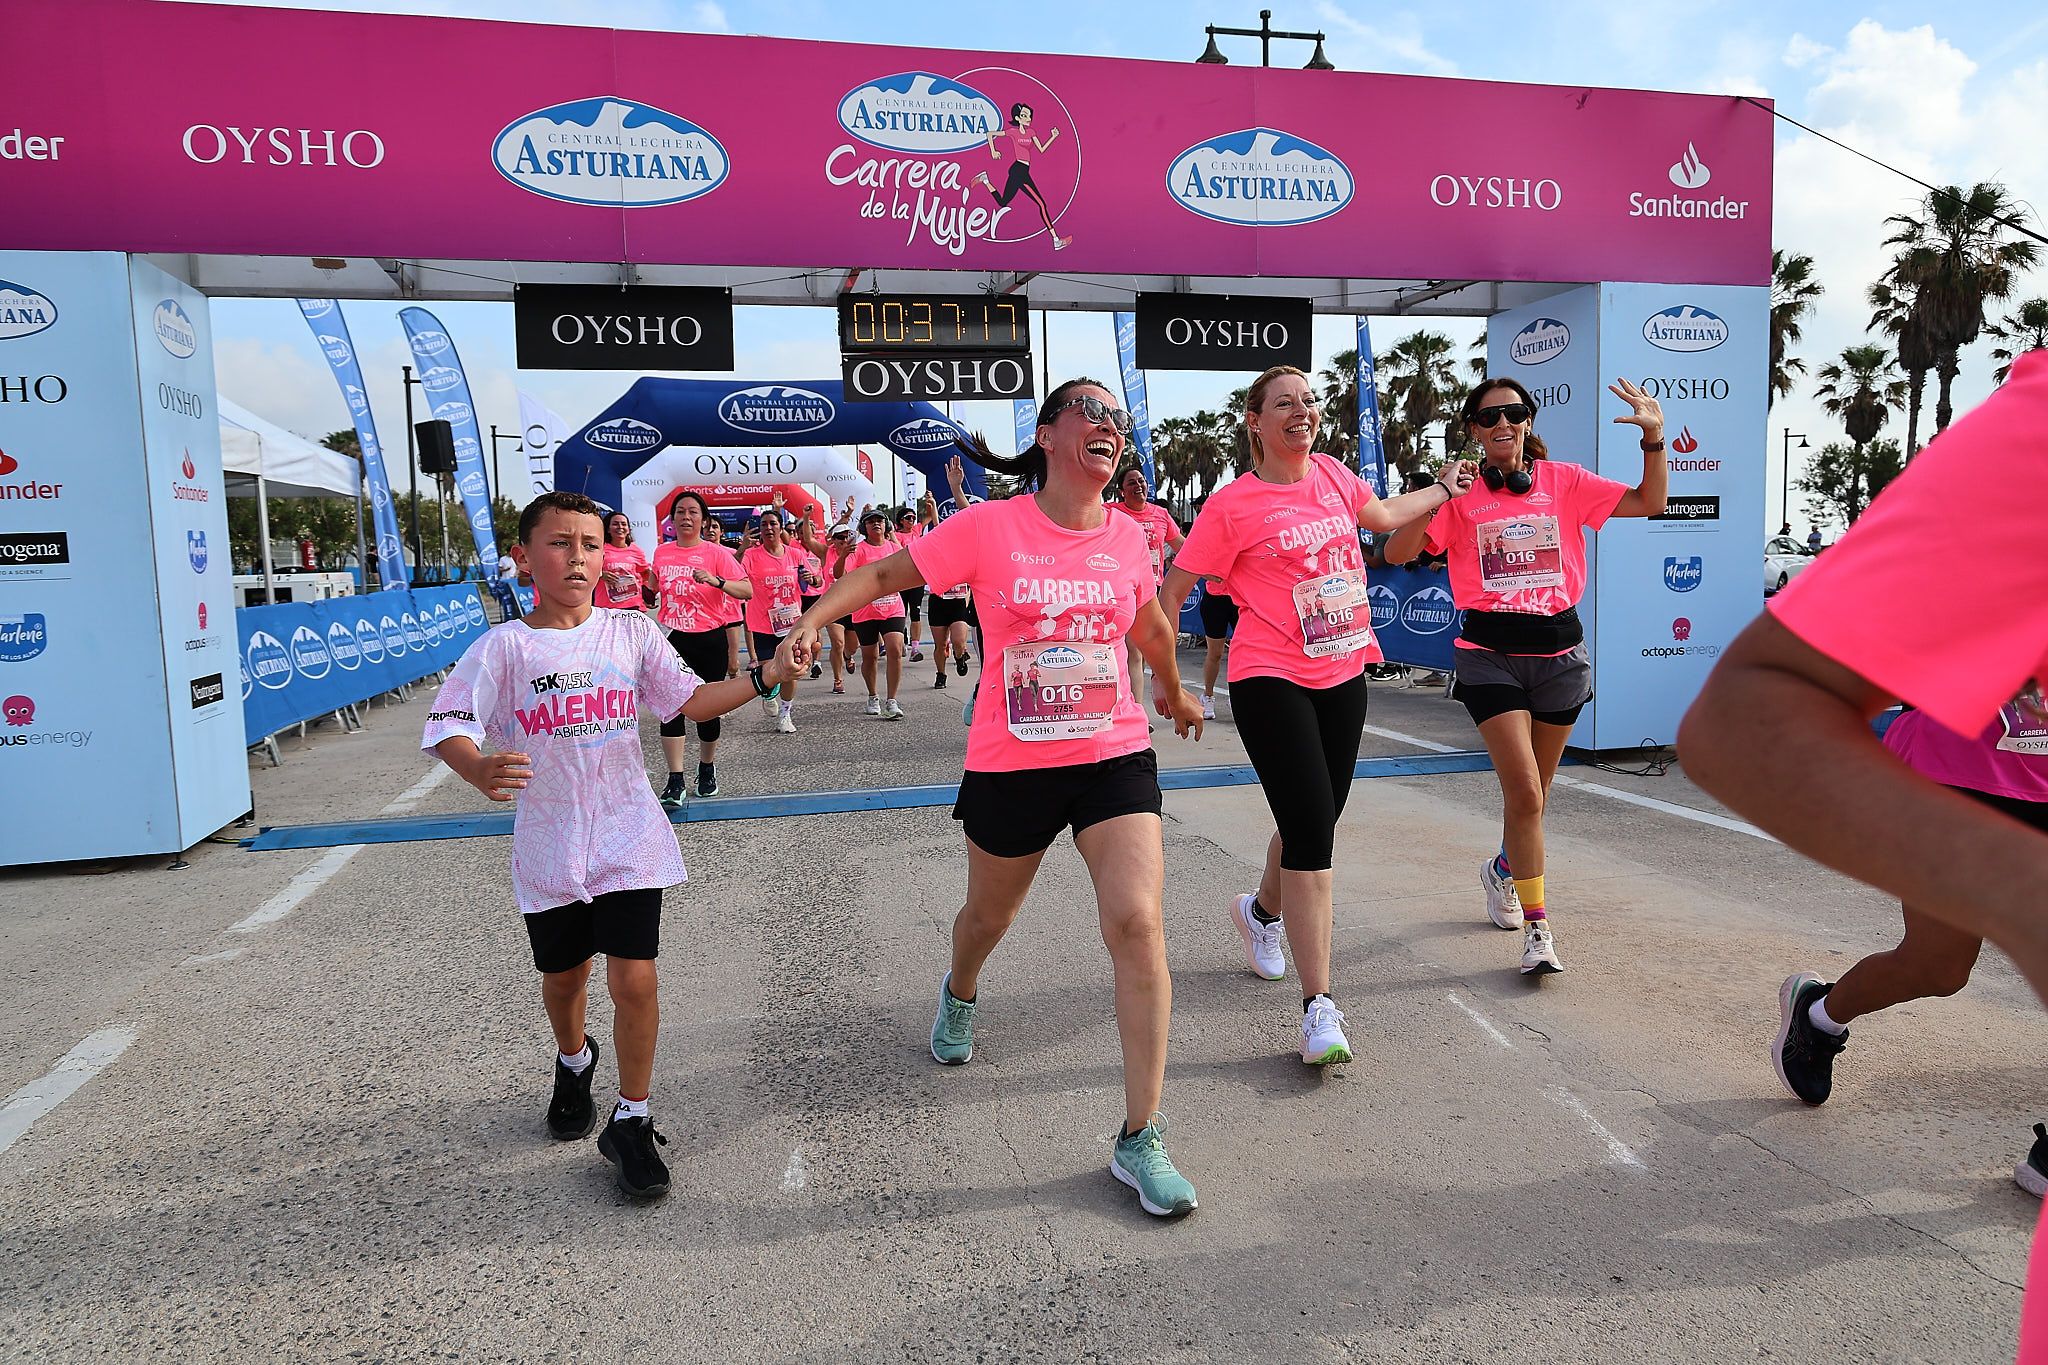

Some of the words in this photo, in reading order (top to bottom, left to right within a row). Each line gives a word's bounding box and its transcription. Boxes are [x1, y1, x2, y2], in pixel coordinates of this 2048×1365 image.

[876, 98, 928, 109] CENTRAL
[933, 101, 985, 111] LECHERA
[851, 98, 990, 134] ASTURIANA
[182, 123, 386, 169] OYSHO
[548, 133, 622, 146] CENTRAL
[630, 136, 703, 149] LECHERA
[512, 134, 712, 181] ASTURIANA
[1211, 160, 1270, 172] CENTRAL
[1276, 163, 1334, 174] LECHERA
[825, 144, 962, 191] Carrera
[1182, 162, 1340, 202] ASTURIANA
[1430, 174, 1562, 211] OYSHO
[1629, 192, 1749, 220] Santander
[860, 189, 887, 218] de
[891, 189, 910, 220] la
[906, 187, 1012, 255] Mujer
[552, 314, 702, 346] OYSHO
[853, 302, 1016, 342] 00:37:17
[1649, 322, 1722, 341] ASTURIANA
[158, 315, 194, 350] ASTURIANA
[1165, 318, 1288, 349] OYSHO
[1515, 334, 1565, 358] ASTURIANA
[852, 359, 1024, 396] OYSHO
[1534, 384, 1571, 409] SHO
[1641, 378, 1729, 400] OYSHO
[159, 383, 202, 420] OYSHO
[728, 400, 827, 422] ASTURIANA
[590, 430, 656, 445] ASTURIANA
[694, 454, 797, 475] OYSHO
[1667, 457, 1721, 471] ntander
[826, 474, 857, 482] OYSHO
[727, 485, 773, 494] Santander
[1264, 507, 1299, 524] OYSHO
[1469, 502, 1500, 517] OYSHO
[1664, 503, 1714, 517] eutrogena
[1010, 551, 1055, 566] OYSHO
[1506, 551, 1536, 564] 016
[1666, 564, 1700, 583] Marlene
[1491, 579, 1517, 588] OYSHO
[1327, 607, 1354, 626] 016
[1404, 603, 1450, 623] ASTURIANA
[1313, 643, 1340, 654] OYSHO
[1642, 645, 1685, 658] octopus
[1041, 656, 1081, 665] ASTURIANA
[530, 672, 560, 694] 15K
[558, 672, 593, 693] 7.5K
[1042, 685, 1084, 703] 016
[514, 687, 637, 738] VALENCIA
[1020, 715, 1043, 723] CARRERA
[1061, 712, 1079, 720] MUJER
[1054, 705, 1073, 713] 2755
[30, 730, 92, 747] energy
[553, 723, 602, 739] ABIERTA
[1021, 726, 1055, 736] OYSHO
[2020, 729, 2047, 737] CARRERA
[2017, 741, 2048, 749] OYSH
